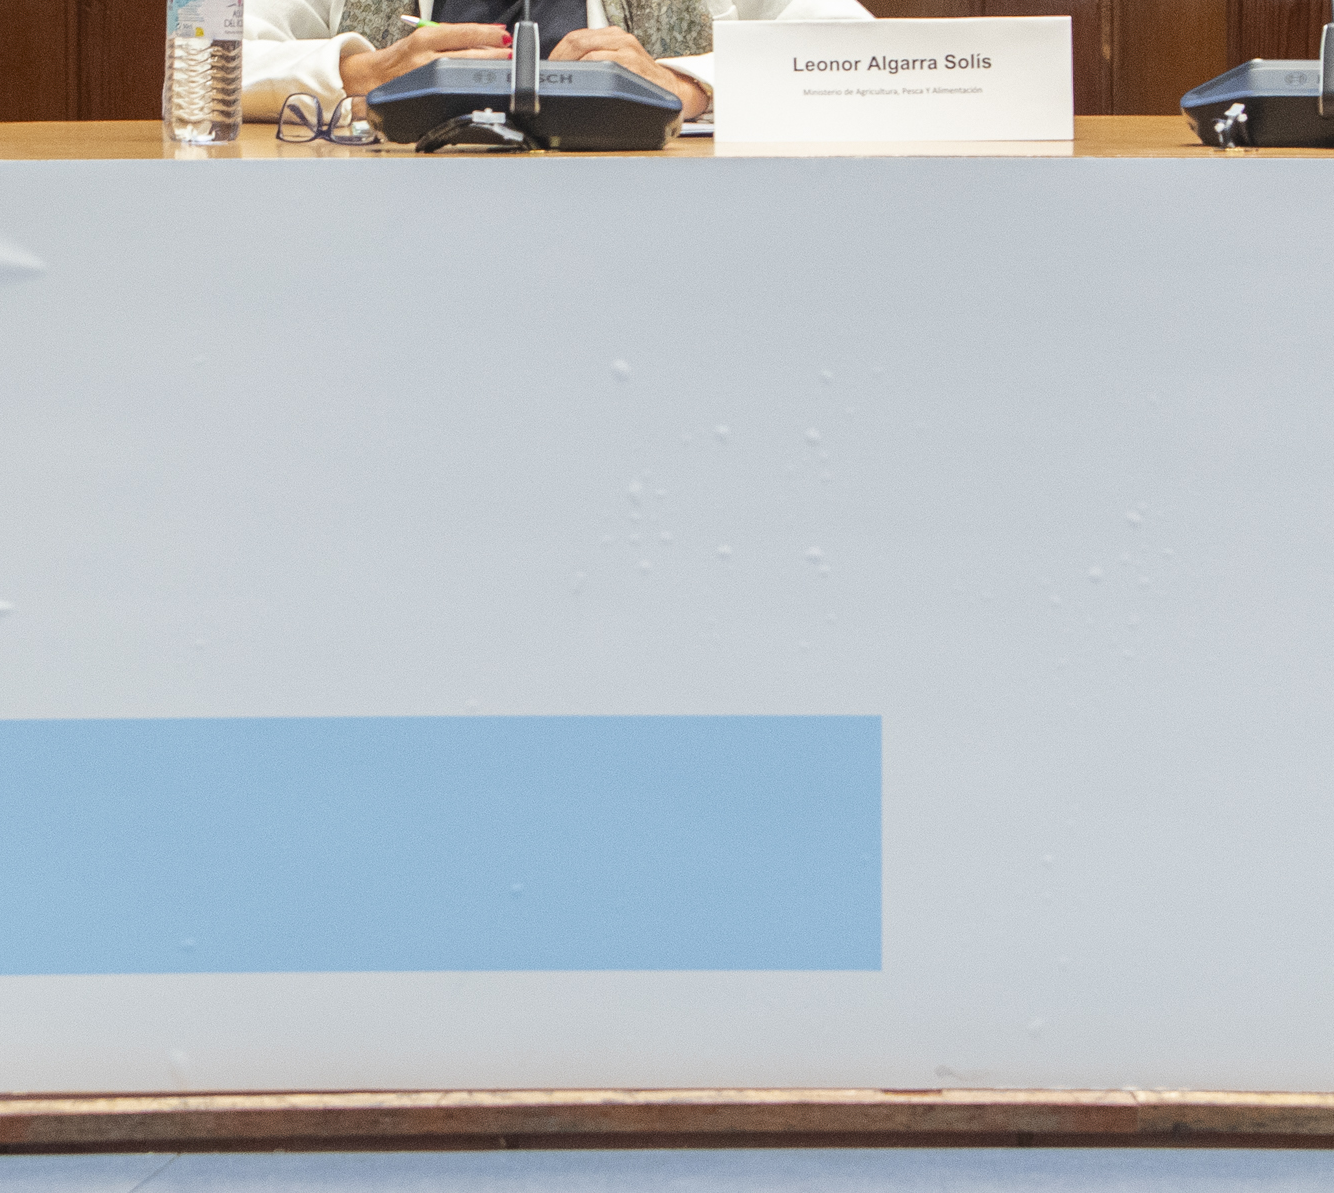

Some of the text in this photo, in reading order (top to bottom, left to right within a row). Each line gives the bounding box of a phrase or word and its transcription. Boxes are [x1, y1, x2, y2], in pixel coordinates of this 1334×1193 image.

[793, 53, 993, 75] Leonor Algarra Solís
[803, 88, 843, 97] Ministerio
[844, 88, 854, 96] de
[855, 87, 900, 98] Agricultura,
[902, 86, 924, 95] Pesca
[932, 85, 984, 95] Alimentación
